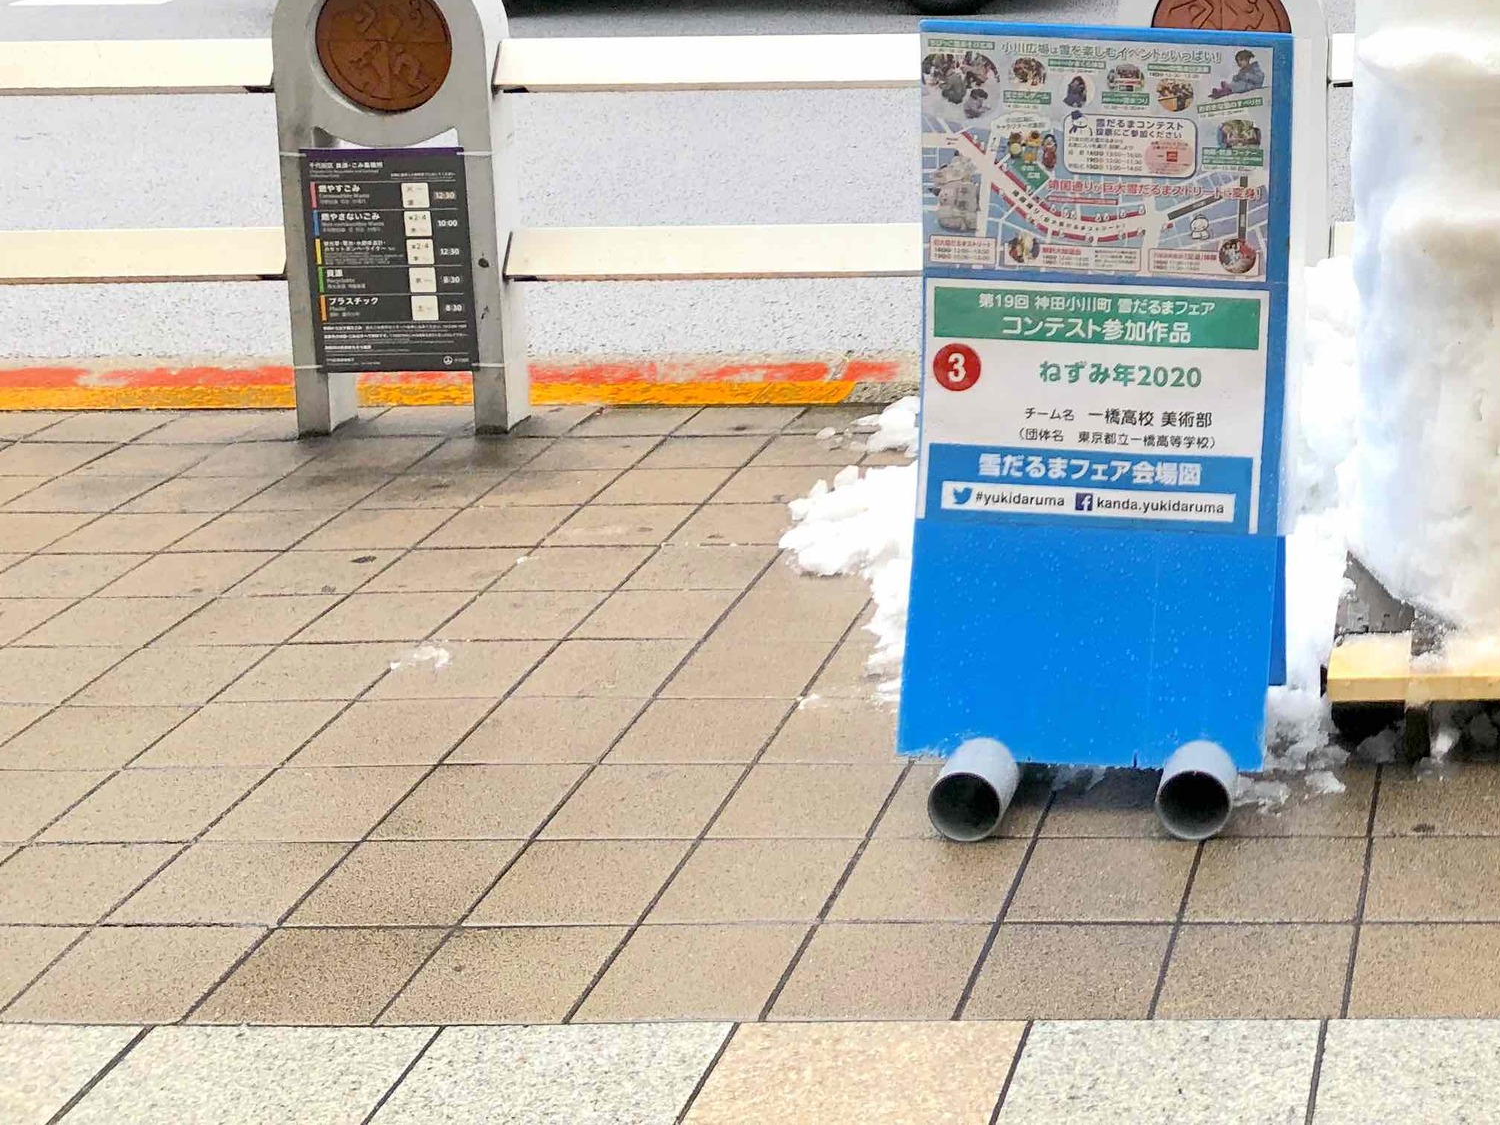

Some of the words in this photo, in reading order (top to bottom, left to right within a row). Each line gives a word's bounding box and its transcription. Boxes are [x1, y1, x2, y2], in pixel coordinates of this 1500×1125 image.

[437, 219, 458, 227] 10:00
[439, 247, 460, 256] 12:30
[329, 296, 379, 306] プラスチック
[979, 292, 1030, 310] 第19回
[1034, 295, 1112, 313] 神田小川町
[1117, 298, 1216, 316] 雪だるまフェア
[1002, 315, 1192, 344] コンテスト参加作品
[947, 352, 967, 384] 3
[1039, 360, 1203, 389] ねずみ年2020
[1024, 407, 1075, 422] チーム名
[1088, 408, 1154, 427] 一橋高校
[1160, 410, 1213, 429] 美術部
[978, 452, 1203, 487] 雪だるまフェア会場図
[976, 490, 1065, 507] #yukidaruma
[1097, 496, 1225, 514] kanda.yukidaruma
